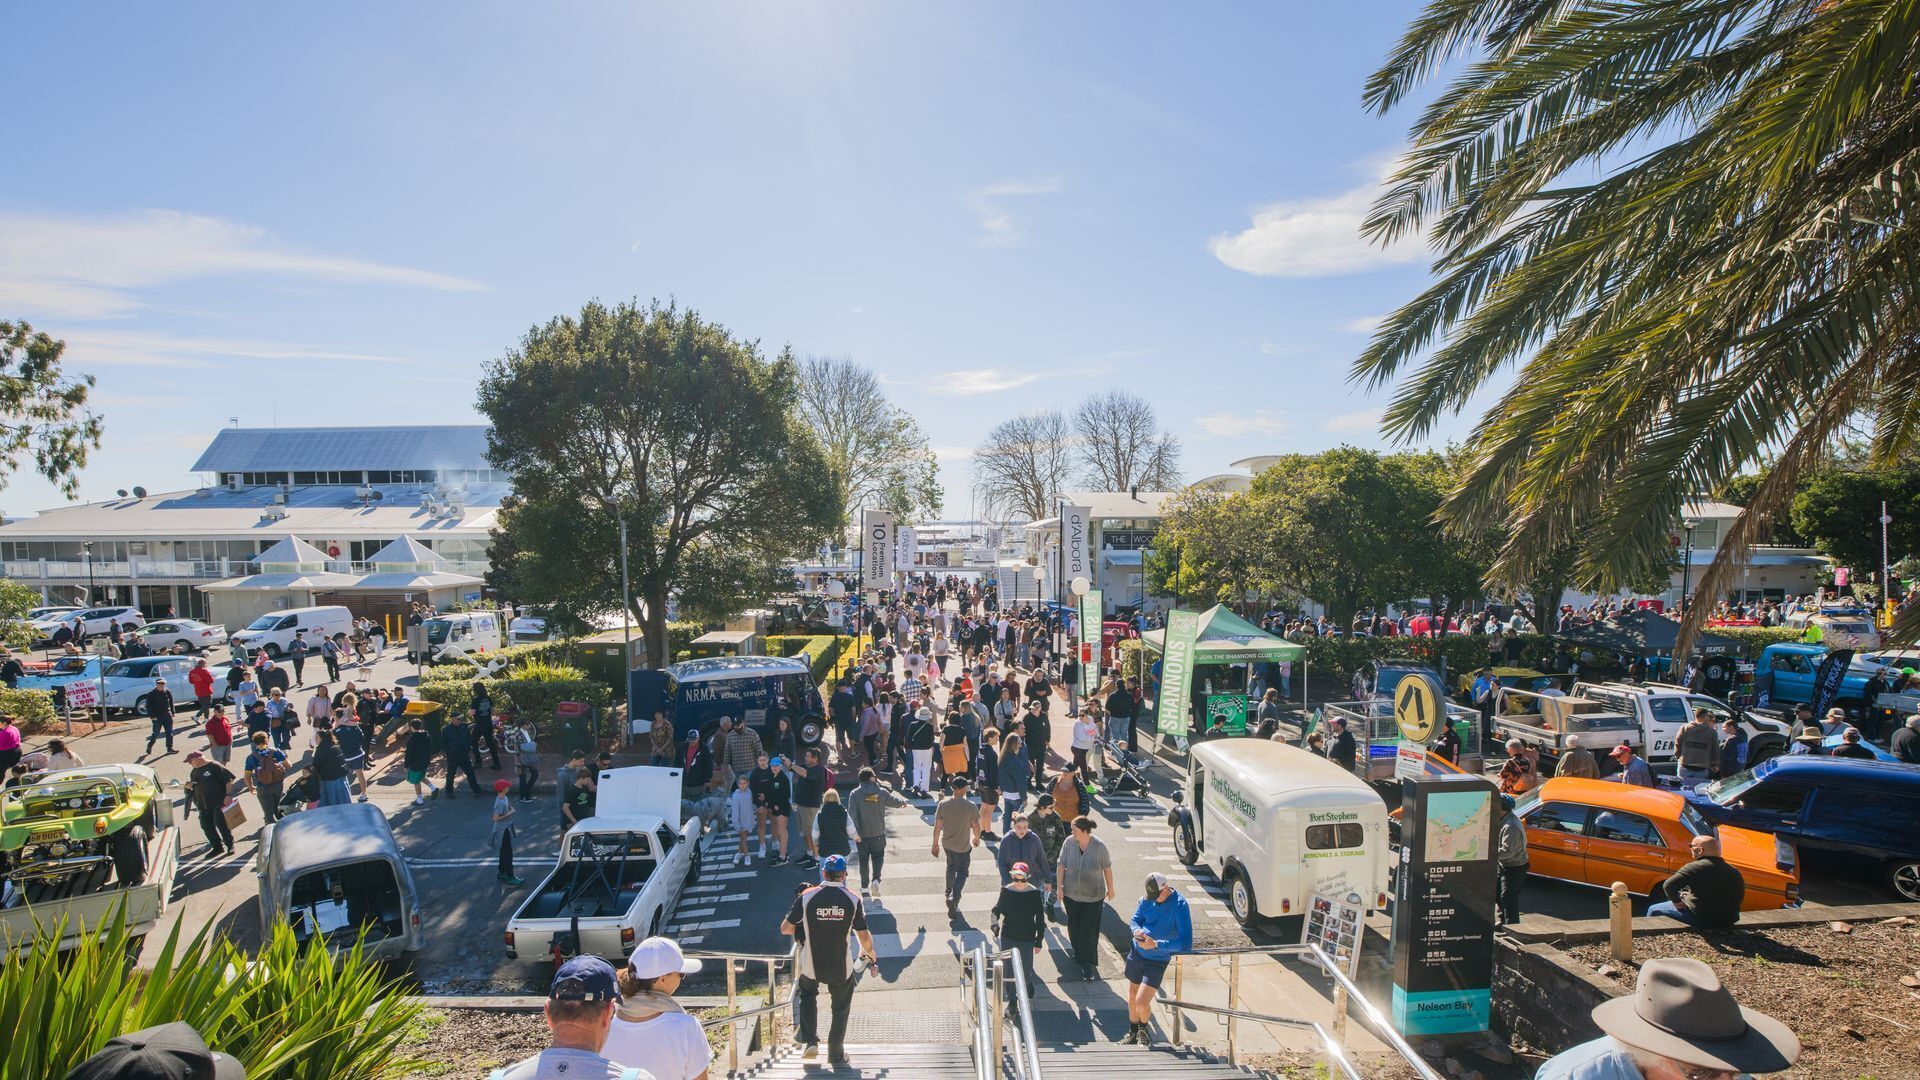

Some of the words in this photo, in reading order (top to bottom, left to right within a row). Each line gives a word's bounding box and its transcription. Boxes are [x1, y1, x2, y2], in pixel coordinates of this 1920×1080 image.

[872, 522, 886, 540] 10
[1070, 514, 1082, 573] d'Albora
[1110, 535, 1126, 543] THE
[1824, 658, 1844, 689] TORQUE
[1161, 640, 1186, 730] SHANNONS
[67, 686, 96, 696] PARKING
[742, 689, 768, 698] SERVICE
[74, 698, 96, 706] SHOW
[1211, 770, 1222, 792] Port
[1224, 779, 1256, 821] Stephens
[1310, 813, 1325, 822] Port
[1326, 812, 1358, 822] Stephens
[1417, 1002, 1451, 1011] Nelson
[1455, 1000, 1473, 1011] Bay
